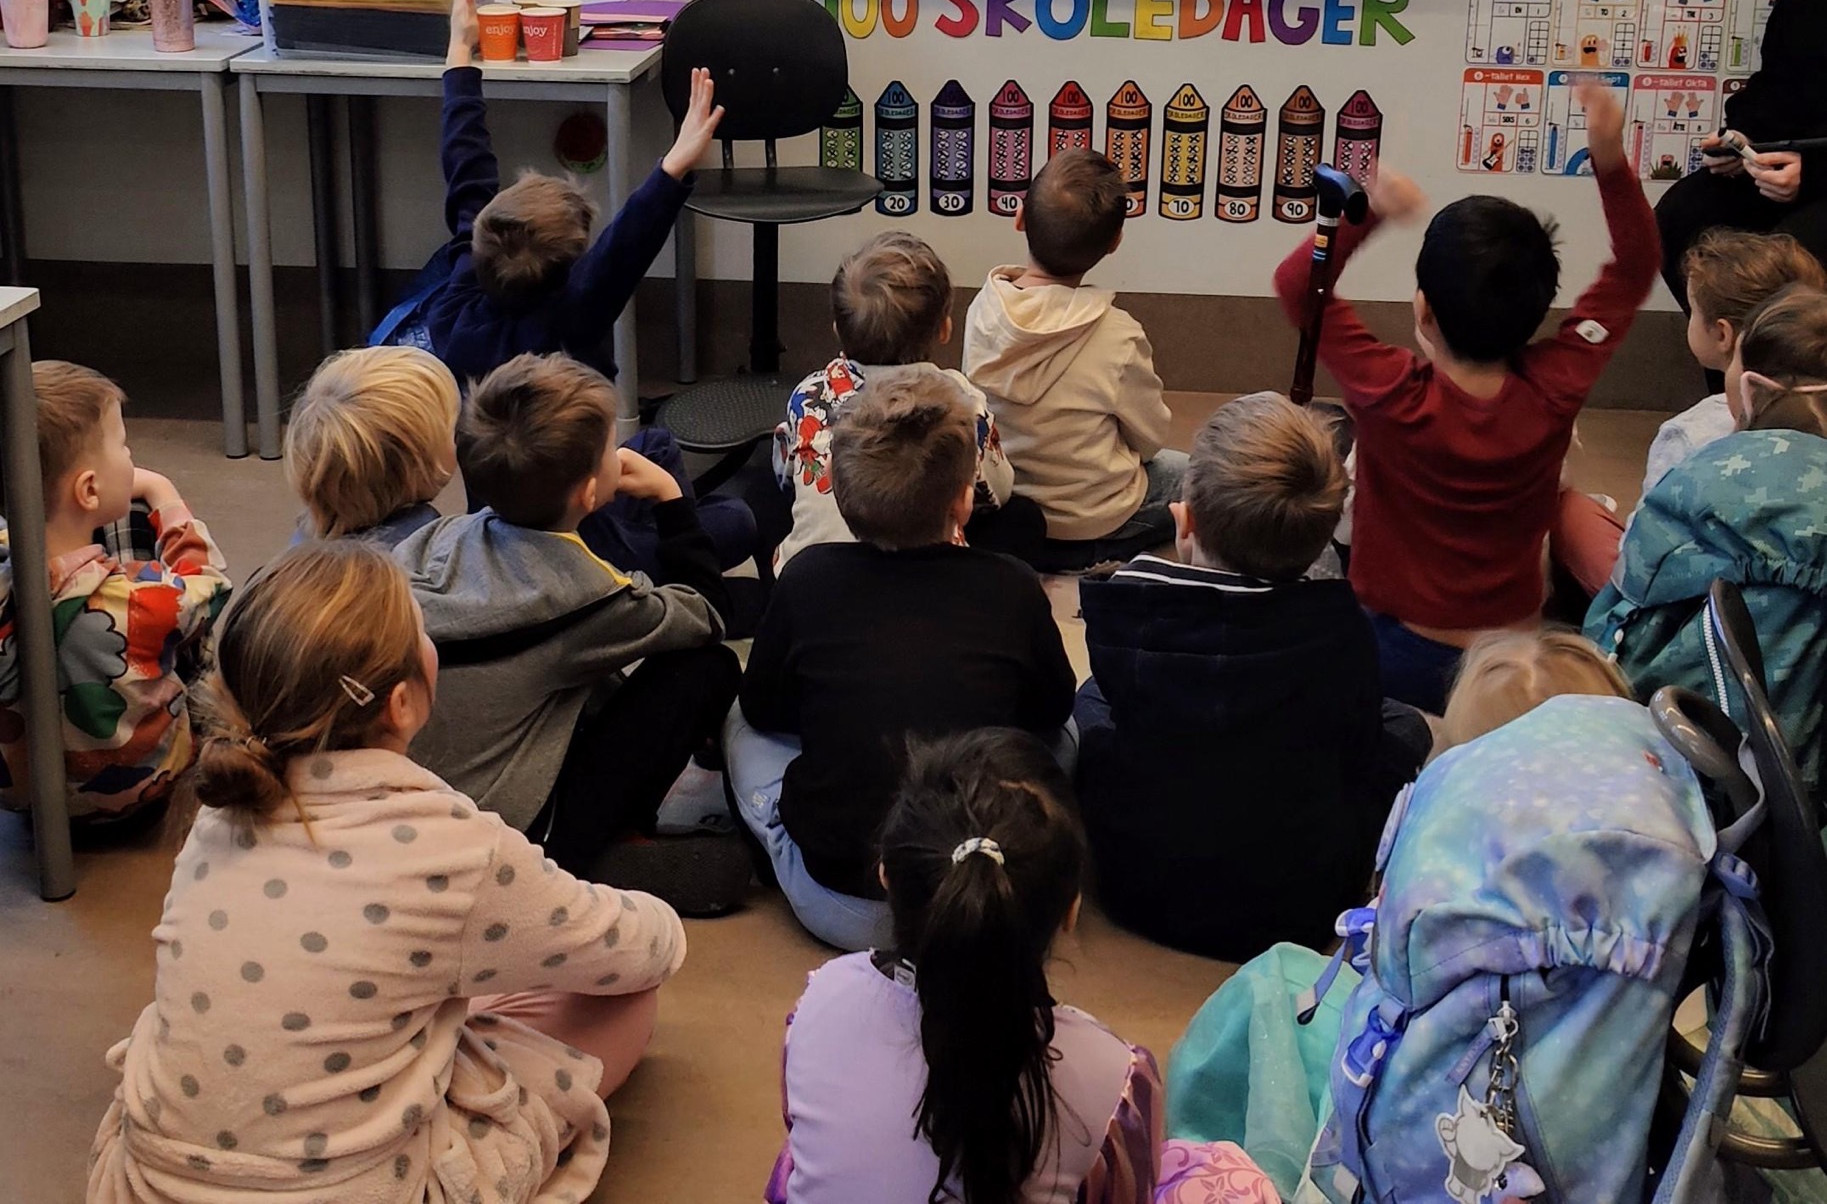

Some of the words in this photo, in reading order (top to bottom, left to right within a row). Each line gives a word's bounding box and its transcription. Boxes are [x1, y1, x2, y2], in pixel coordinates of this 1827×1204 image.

[888, 91, 904, 104] 100
[1003, 90, 1019, 103] 100
[1063, 91, 1080, 104] 100
[1120, 91, 1137, 104] 100
[1178, 94, 1195, 107] 100
[1235, 95, 1252, 108] 100
[1294, 96, 1311, 109] 100
[1351, 100, 1369, 114] 100
[889, 197, 905, 209] 20
[944, 196, 960, 208] 30
[1001, 197, 1017, 209] 40
[1173, 200, 1189, 213] 70
[1229, 202, 1246, 215] 80
[1287, 202, 1303, 216] 90
